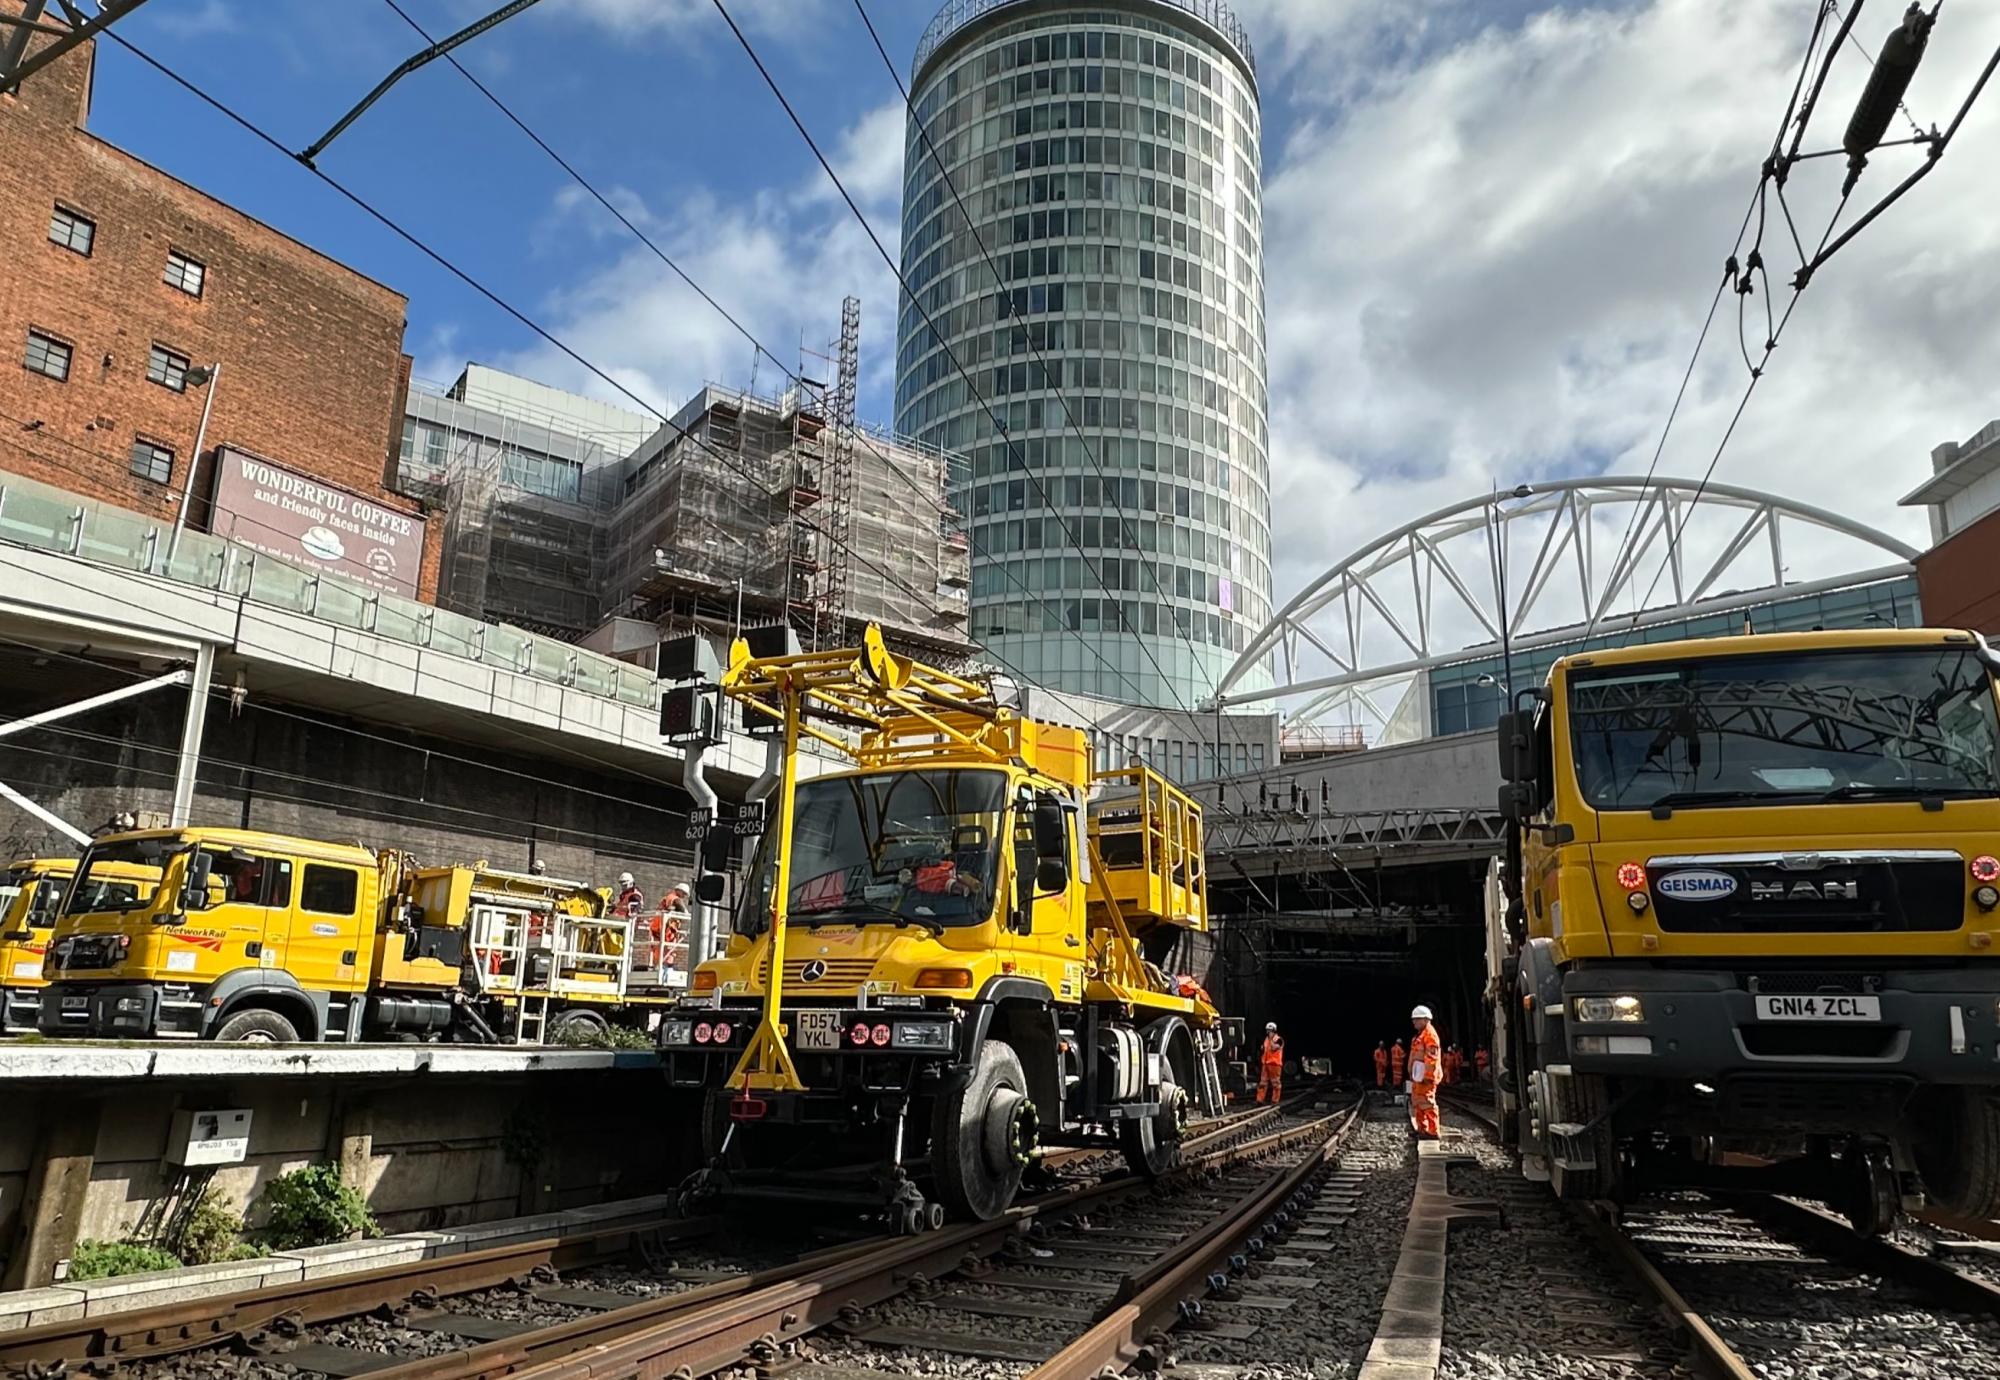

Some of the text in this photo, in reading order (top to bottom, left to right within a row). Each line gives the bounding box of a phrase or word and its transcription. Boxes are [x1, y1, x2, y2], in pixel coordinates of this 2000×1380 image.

[241, 460, 412, 537] WONDERFUL COFFEE
[253, 489, 396, 547] and friendly faces inside
[690, 810, 708, 823] BM
[739, 805, 758, 818] BM
[733, 821, 761, 835] 6205
[1660, 879, 1858, 900] GEISMAR MAN
[1769, 998, 1867, 1017] GN14 ZCL
[800, 1013, 837, 1030] FD57
[805, 1031, 831, 1047] YKL
